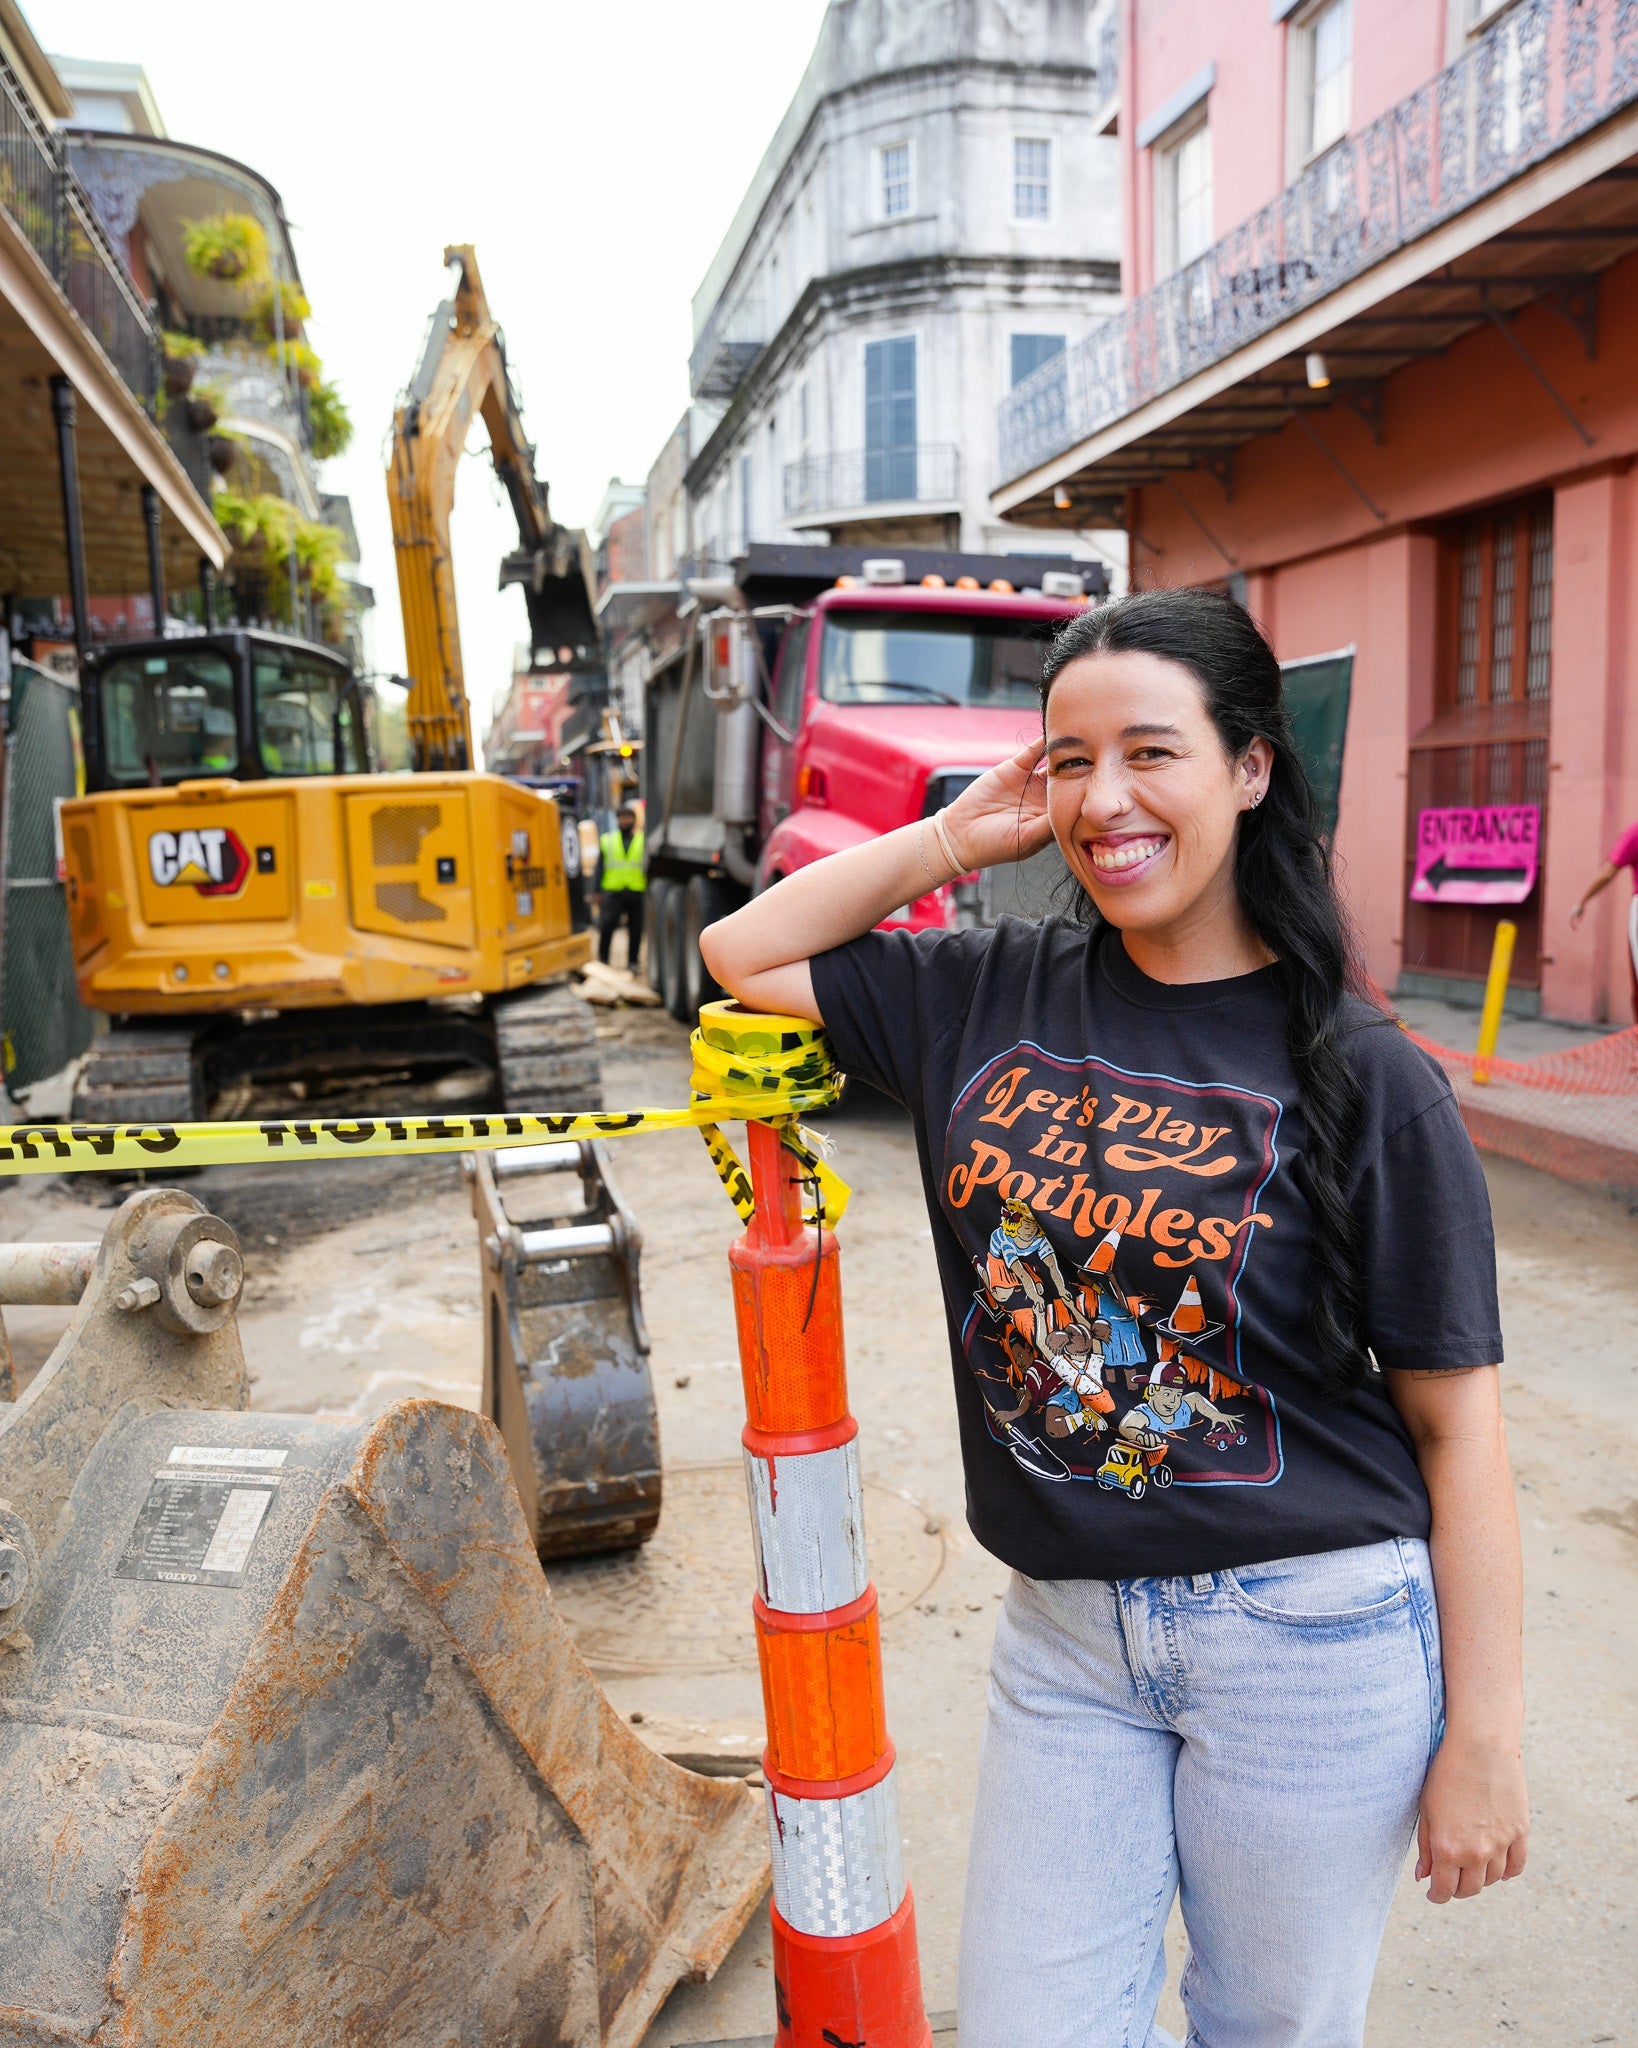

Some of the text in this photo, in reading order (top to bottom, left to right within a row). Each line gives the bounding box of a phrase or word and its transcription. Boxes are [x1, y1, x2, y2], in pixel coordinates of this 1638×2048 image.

[1423, 810, 1534, 847] ENTRANCE
[149, 828, 226, 886] CAT
[978, 1066, 1238, 1177] Let's Play
[1028, 1125, 1088, 1167] in
[948, 1139, 1274, 1269] Potholes
[157, 1572, 197, 1582] VOLVO
